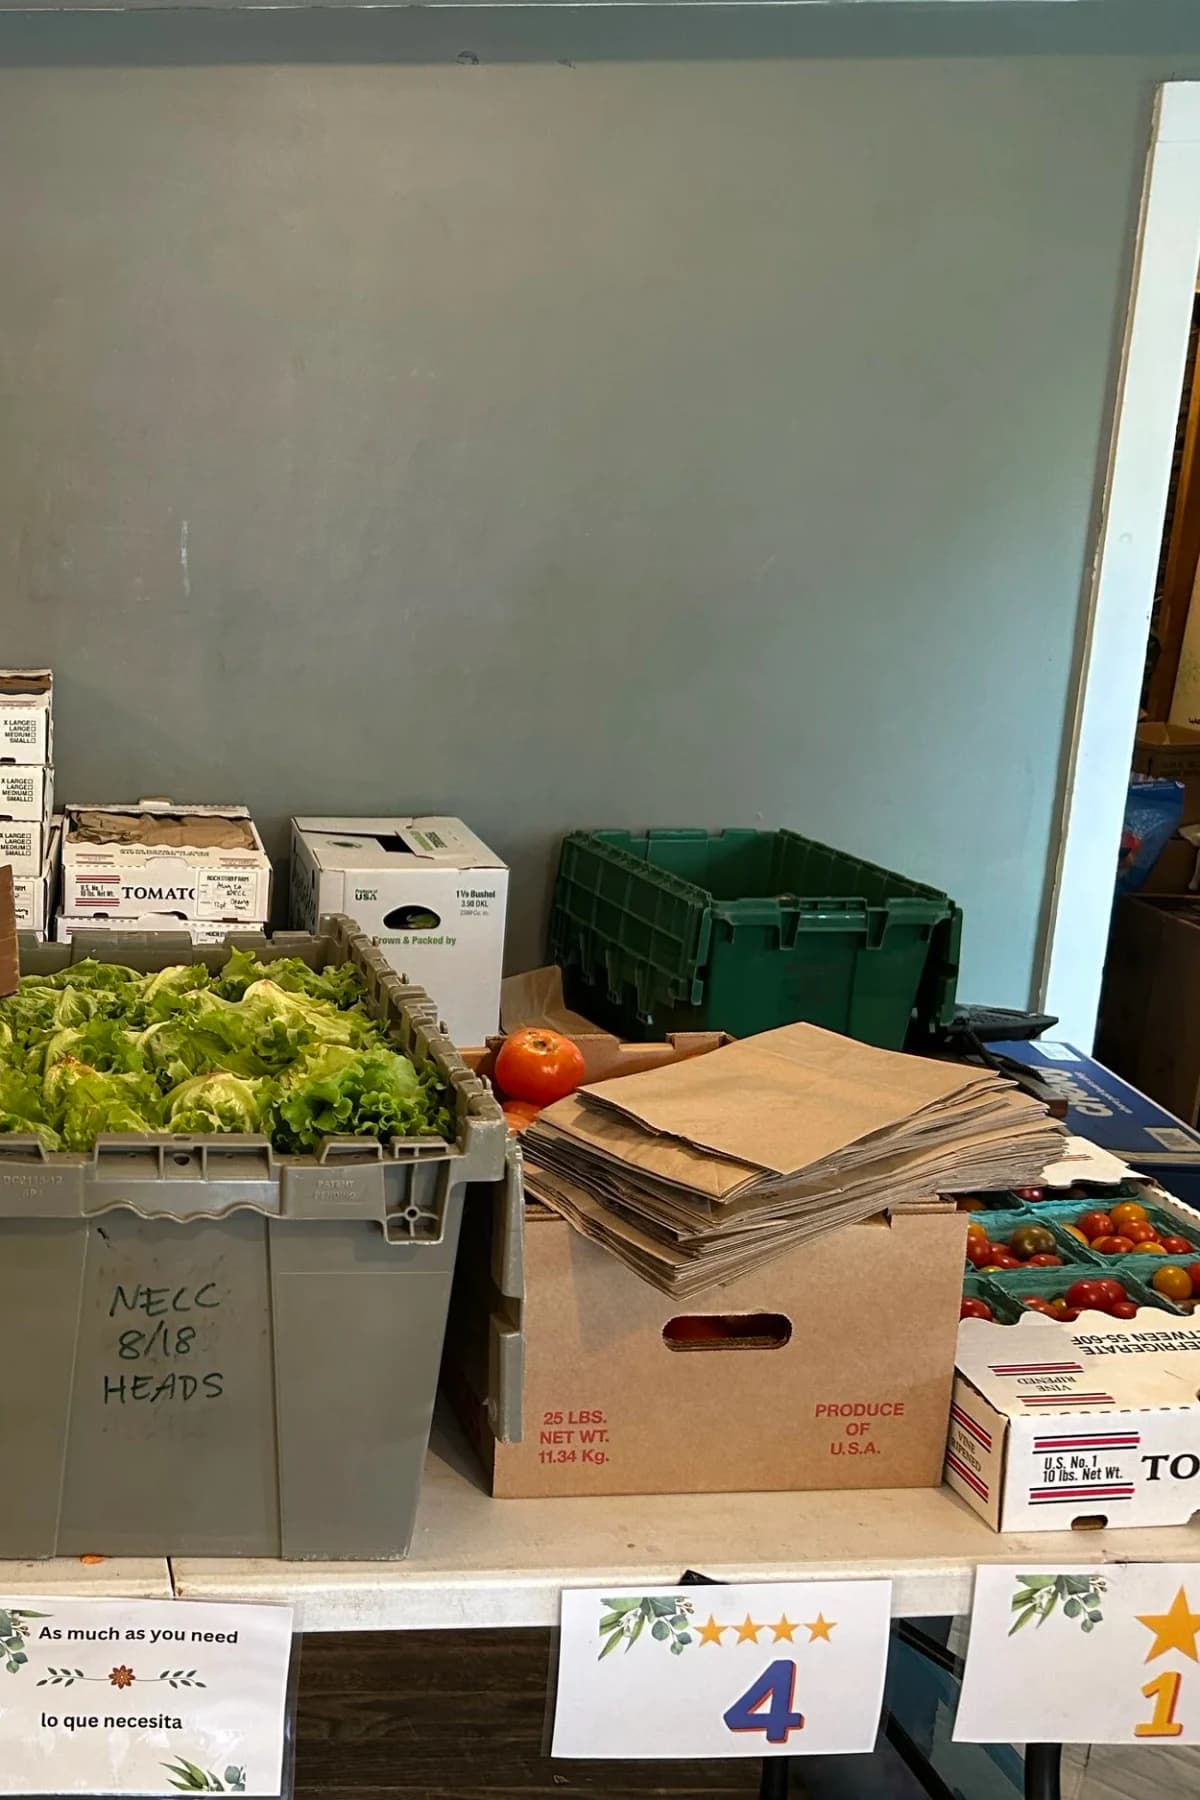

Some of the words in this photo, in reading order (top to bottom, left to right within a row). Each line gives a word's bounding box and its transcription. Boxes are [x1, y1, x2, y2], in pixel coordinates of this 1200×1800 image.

[121, 886, 196, 900] TOMAT
[355, 893, 377, 901] USA
[470, 890, 496, 898] Bushel
[403, 936, 410, 944] &
[412, 936, 444, 944] Packed
[446, 936, 456, 946] by
[109, 1283, 220, 1317] NECC
[118, 1320, 196, 1360] 8/18
[1078, 1341, 1200, 1355] EFRIGERATE
[104, 1372, 224, 1404] HEADS
[1016, 1376, 1077, 1385] RIPENED
[1035, 1384, 1072, 1392] VINE
[543, 1411, 563, 1425] 25
[568, 1410, 607, 1425] LBS.
[815, 1402, 905, 1418] PRODUCE
[845, 1422, 872, 1437] OF
[539, 1431, 575, 1445] NET
[580, 1430, 610, 1444] WT.
[830, 1441, 881, 1456] U.S.A.
[538, 1450, 577, 1465] 11.34
[581, 1449, 610, 1465] Kg.
[1044, 1456, 1066, 1470] U.S.
[1070, 1455, 1089, 1469] No.
[1092, 1455, 1098, 1467] 1
[1043, 1470, 1056, 1483] 10
[1059, 1469, 1078, 1482] lbs.
[1082, 1467, 1103, 1481] Net
[1105, 1466, 1124, 1479] Wt.
[39, 1627, 62, 1640] As
[67, 1626, 120, 1641] much
[125, 1629, 146, 1641] as
[150, 1629, 186, 1643] you
[191, 1630, 238, 1644] need
[723, 1659, 805, 1743] 4
[1134, 1670, 1184, 1737] 1
[41, 1712, 58, 1728] lo
[63, 1715, 99, 1731] que
[104, 1713, 183, 1729] necesita
